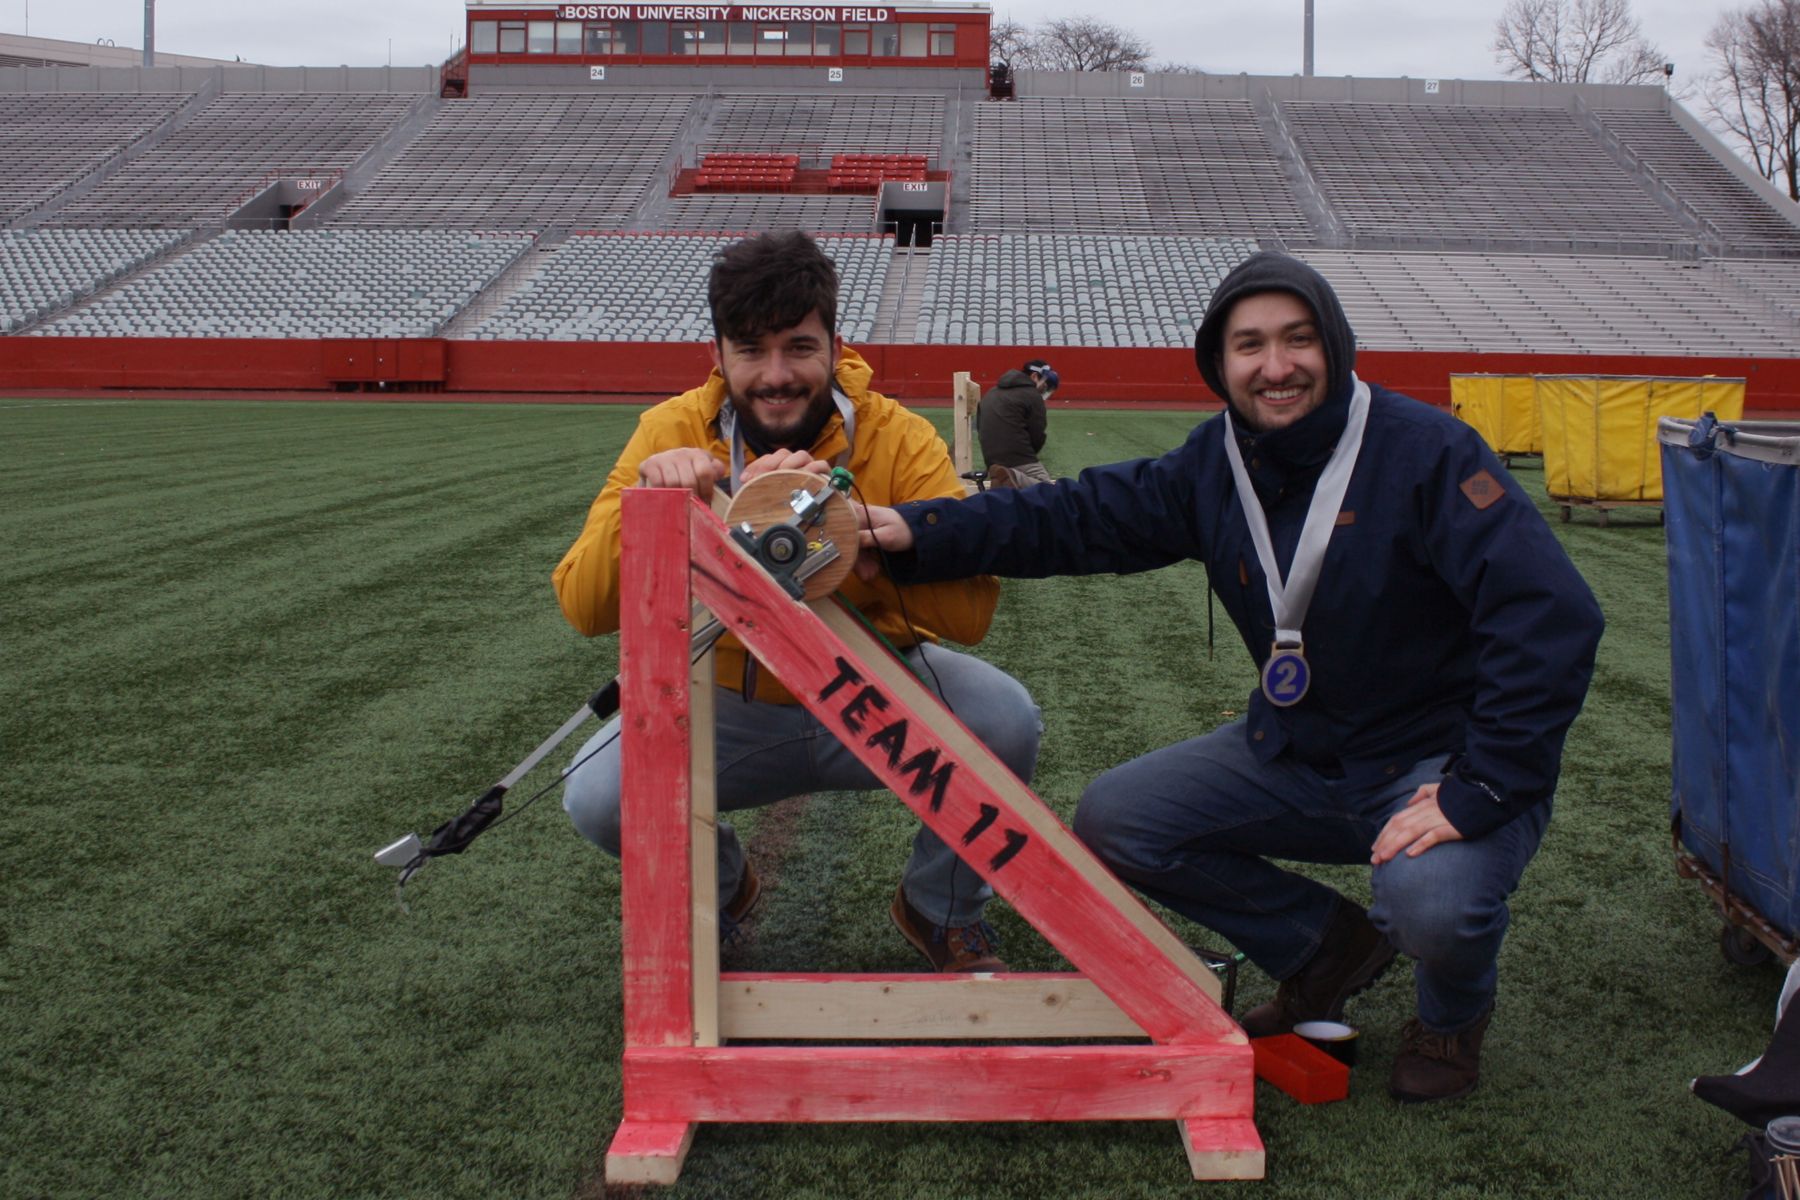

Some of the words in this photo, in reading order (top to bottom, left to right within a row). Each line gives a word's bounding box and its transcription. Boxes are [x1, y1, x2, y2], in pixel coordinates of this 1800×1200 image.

[565, 6, 630, 19] BOSTON
[636, 7, 730, 20] UNIVERSITY
[742, 7, 836, 21] NICKERSON
[842, 8, 888, 21] FIELD
[591, 68, 603, 77] 24
[830, 70, 842, 79] 25
[1132, 75, 1143, 85] 26
[1427, 81, 1438, 91] 27
[299, 180, 320, 189] EXIT
[904, 183, 927, 191] EXIT
[1275, 661, 1298, 694] 2
[816, 656, 957, 813] TEAM
[962, 803, 1028, 873] 11
